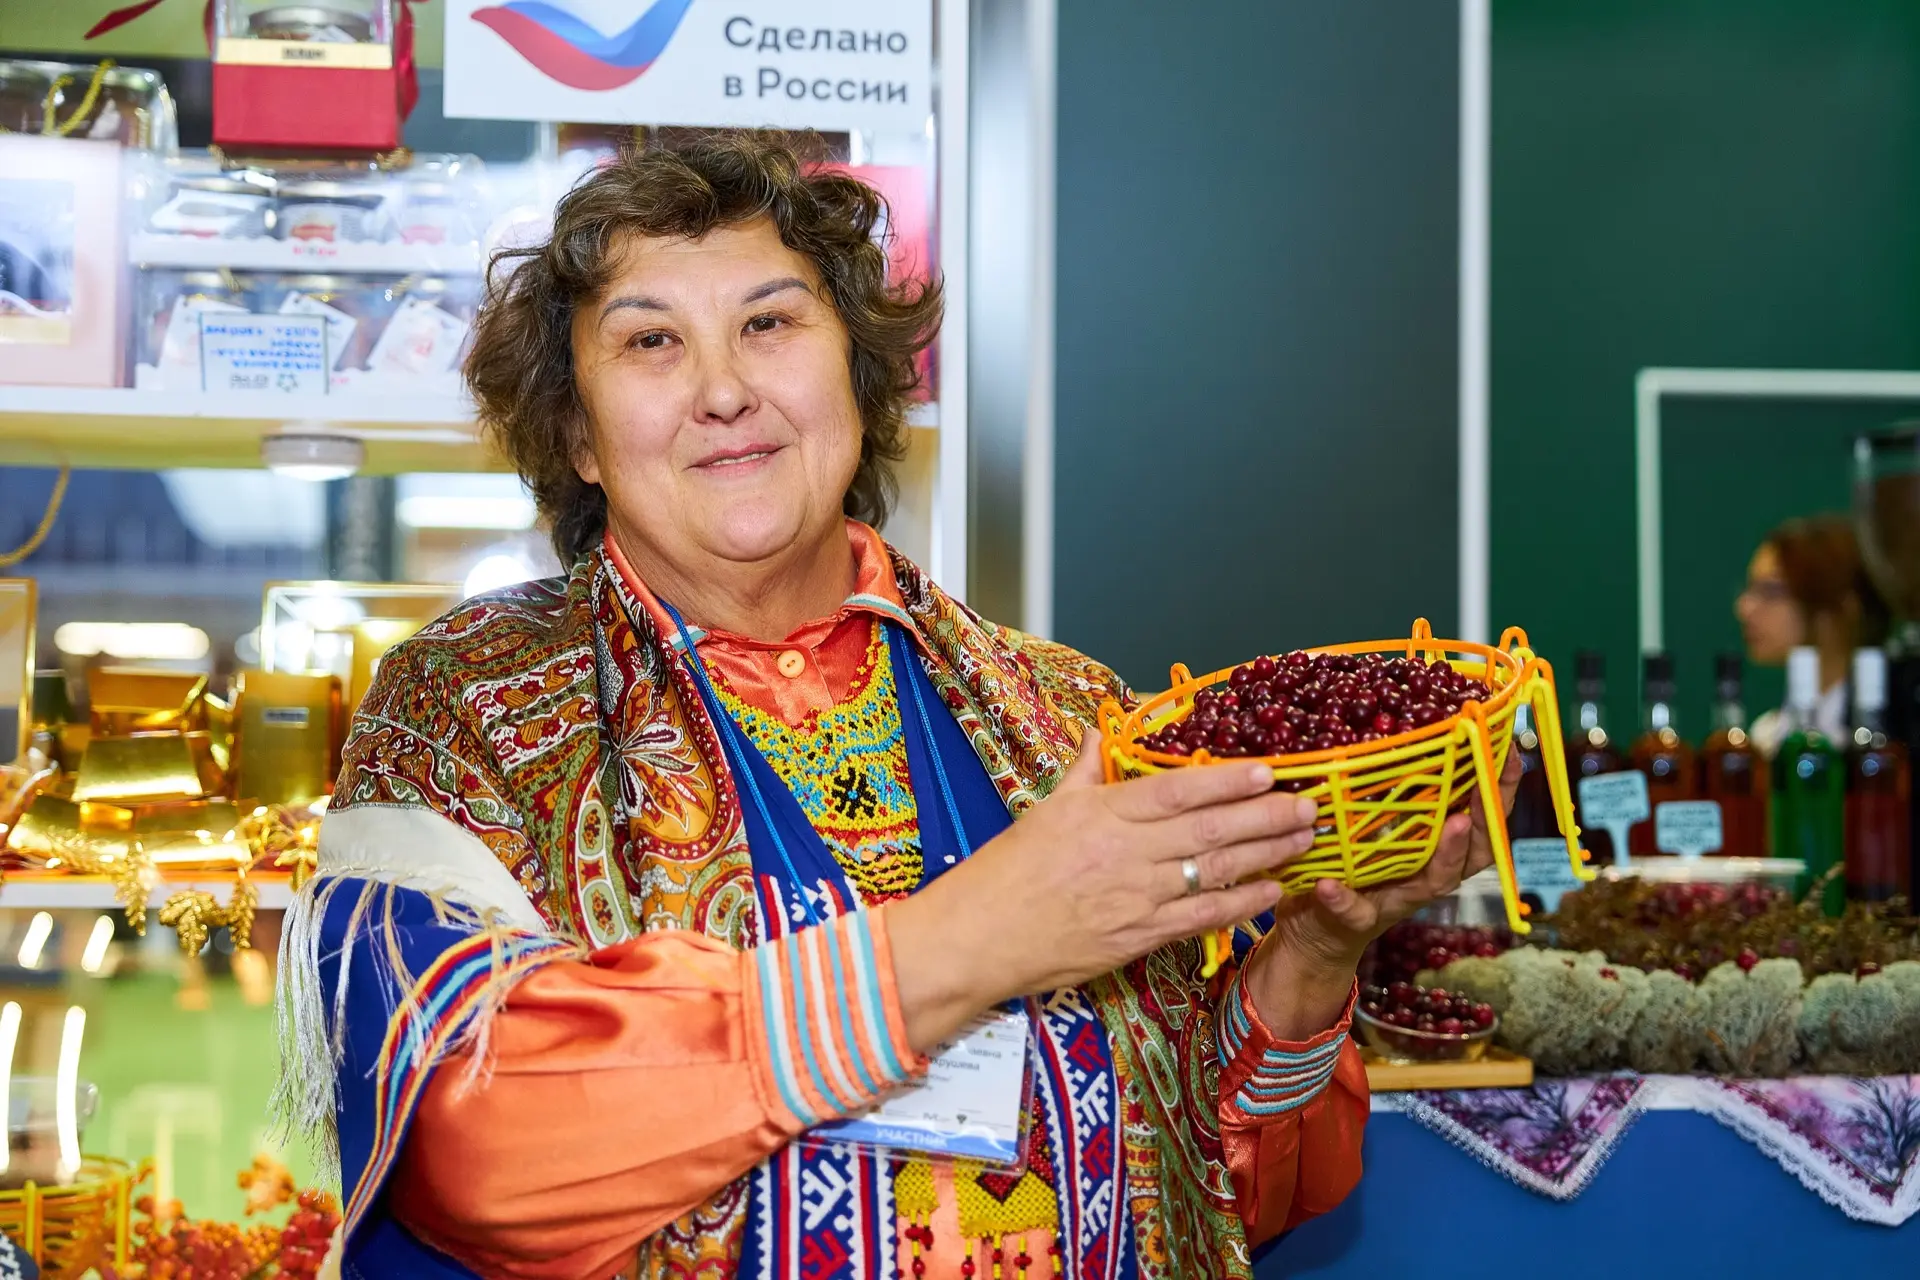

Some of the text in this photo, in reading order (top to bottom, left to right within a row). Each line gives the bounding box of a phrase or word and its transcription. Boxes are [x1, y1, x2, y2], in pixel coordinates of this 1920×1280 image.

[724, 16, 908, 54] Сделано
[724, 67, 908, 103] в России
[875, 1127, 948, 1147] УЧАСТНИК
